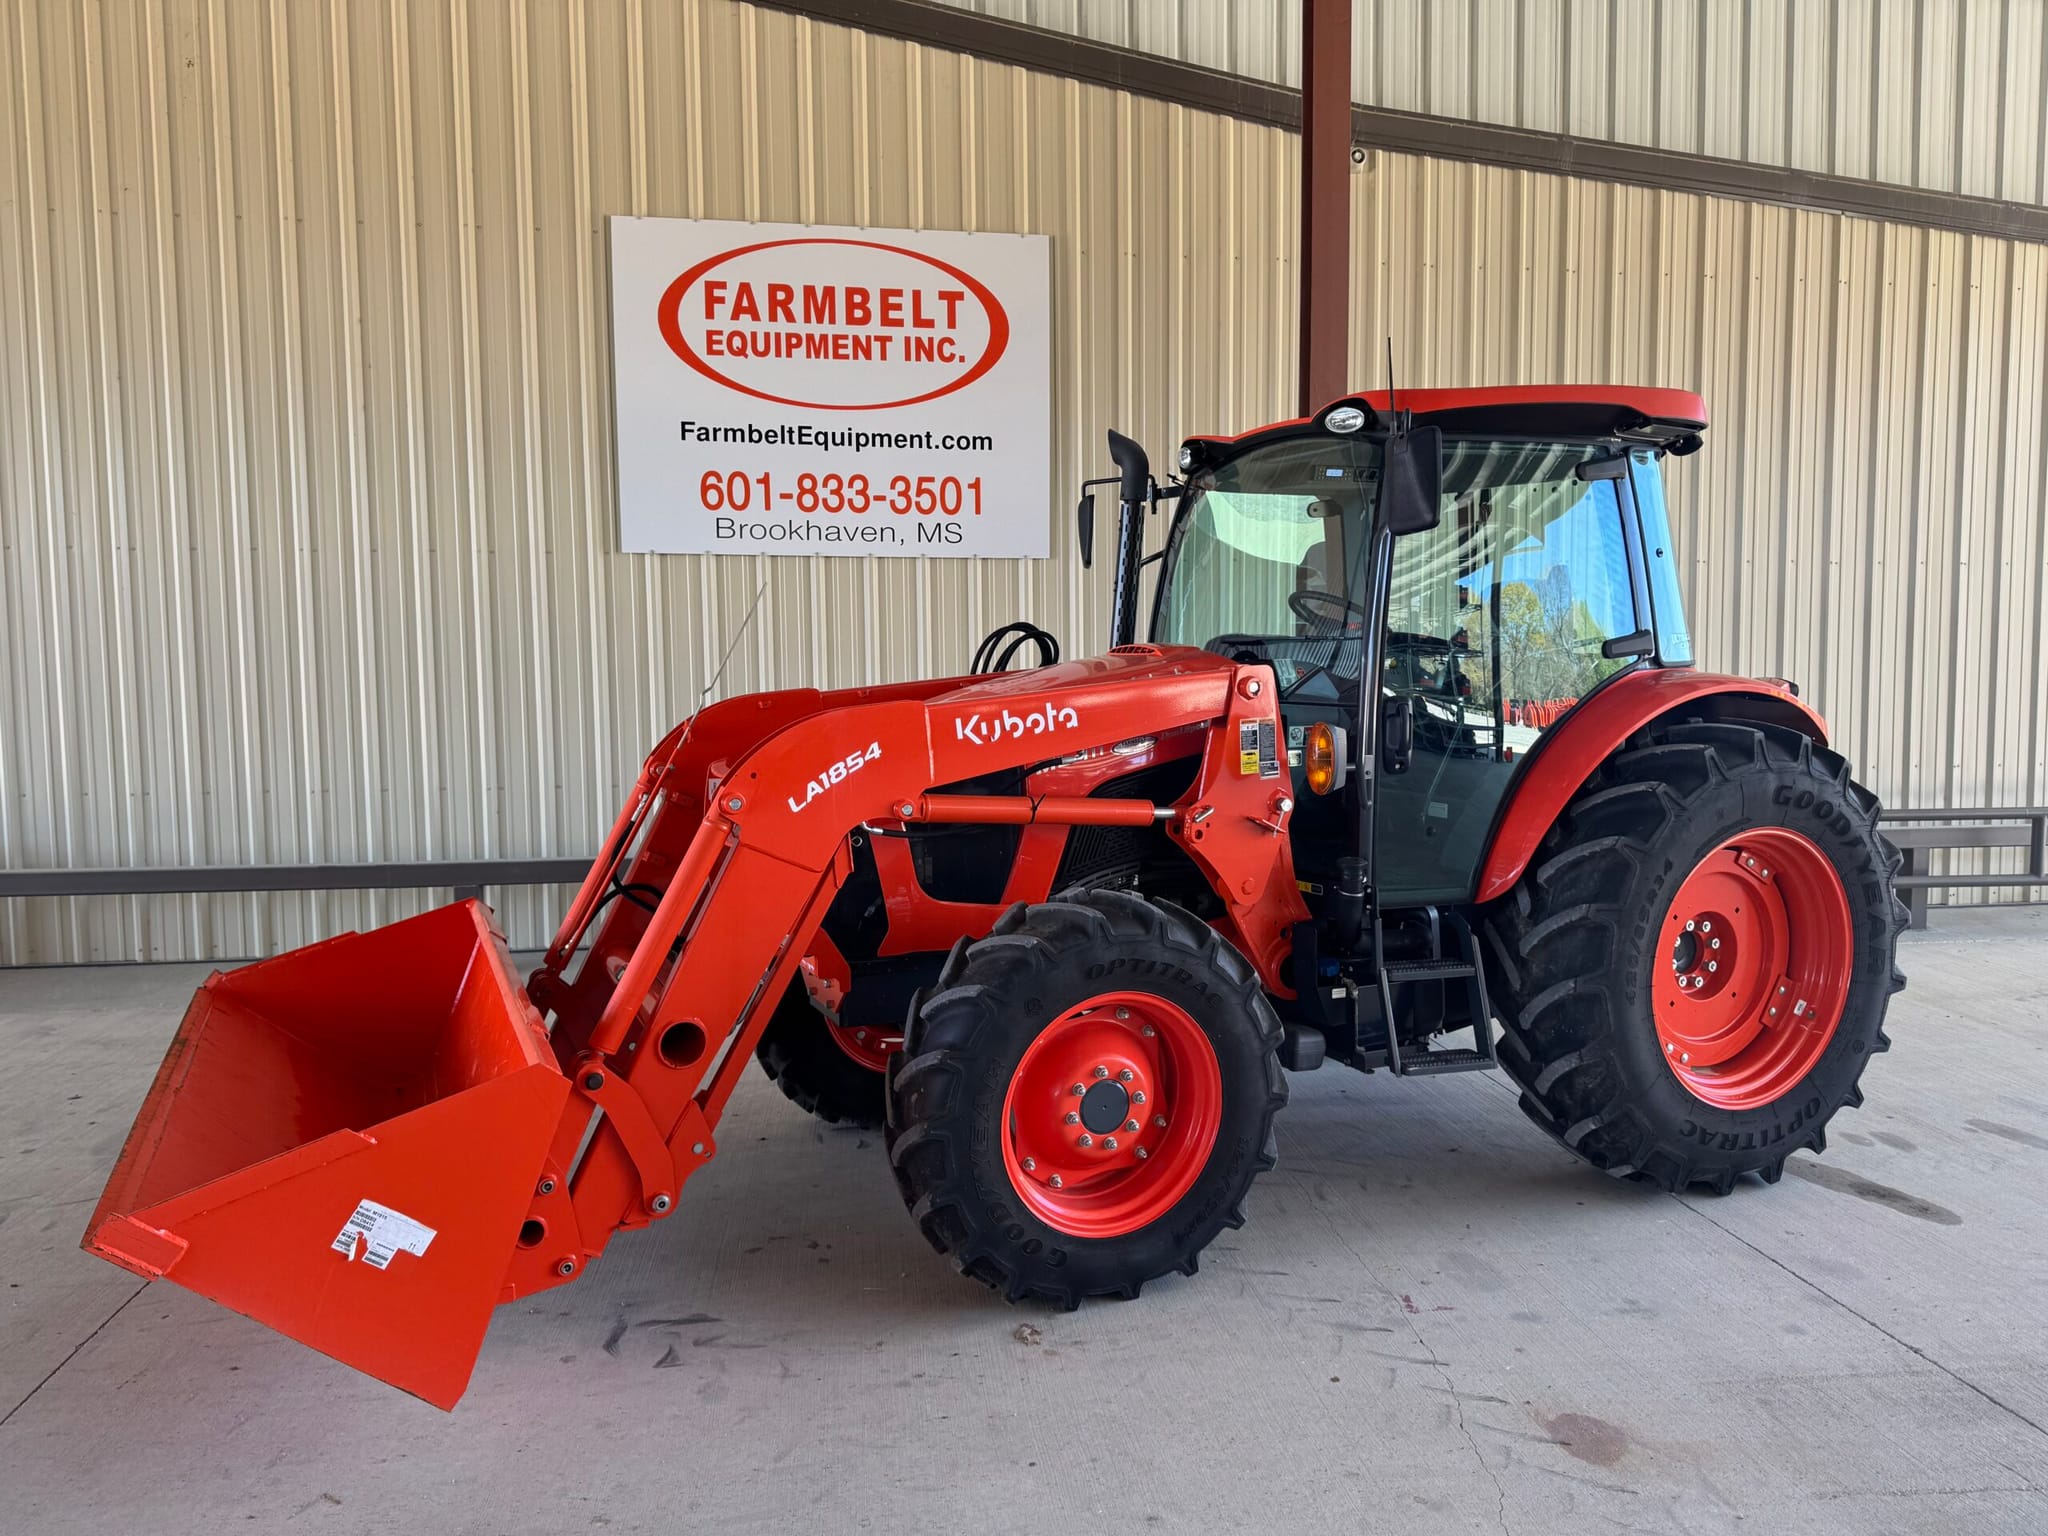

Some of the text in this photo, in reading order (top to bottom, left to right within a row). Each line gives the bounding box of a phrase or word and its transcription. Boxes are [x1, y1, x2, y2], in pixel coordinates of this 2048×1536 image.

[704, 280, 965, 329] FARMBELT
[705, 329, 966, 363] EQUIPMENT INC.
[680, 421, 993, 452] FarmbeltEquipment.com
[700, 470, 982, 516] 601-833-3501
[715, 518, 963, 546] Brookhaven, MS
[955, 703, 1078, 744] Kubota
[788, 741, 882, 813] LA1854
[1771, 784, 1887, 977] GOODYEAR
[1085, 957, 1225, 1009] OPTITRAC
[1679, 1097, 1824, 1152] OPTITRAC
